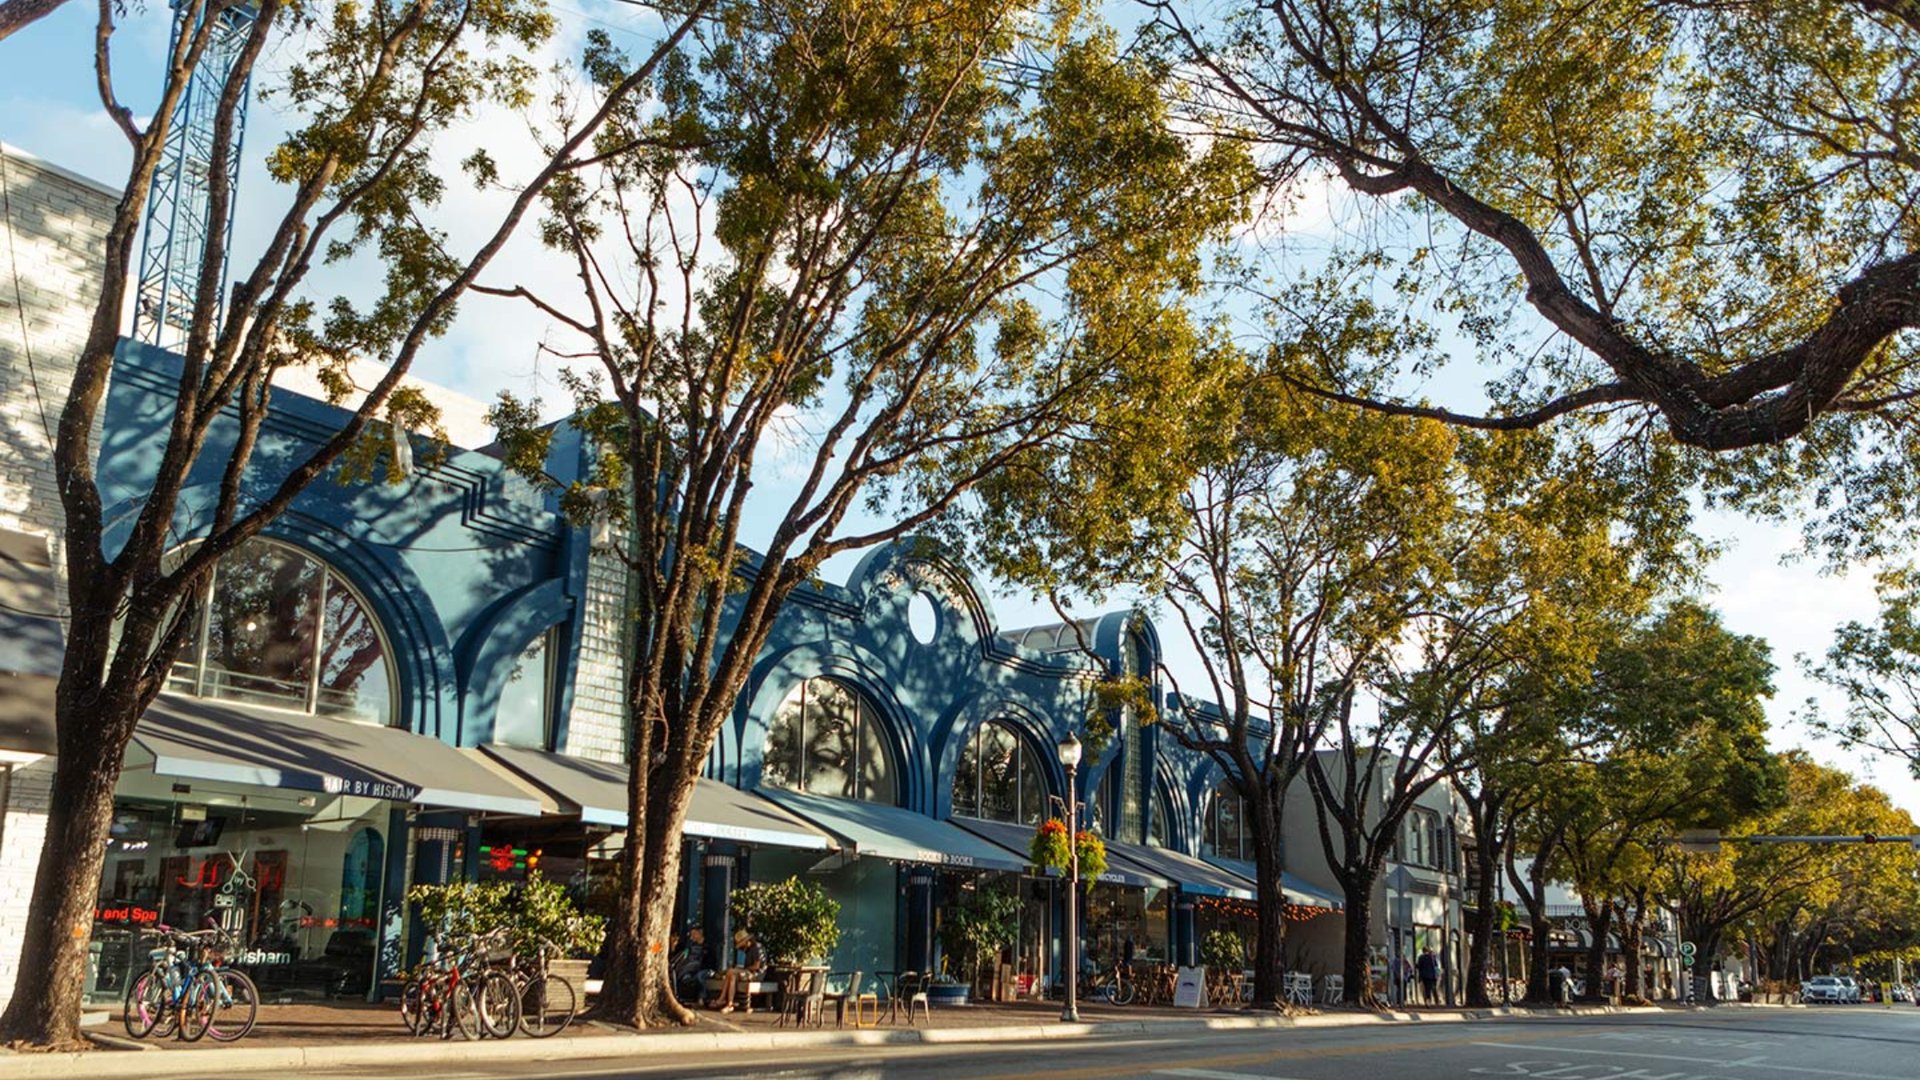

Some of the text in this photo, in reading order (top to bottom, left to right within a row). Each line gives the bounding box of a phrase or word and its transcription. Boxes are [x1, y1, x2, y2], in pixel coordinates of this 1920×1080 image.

[323, 776, 415, 799] HAIR BY HISHAM
[917, 849, 942, 863] BOOKS
[951, 855, 974, 866] BOOKS
[103, 907, 128, 920] and
[132, 907, 158, 923] Spa
